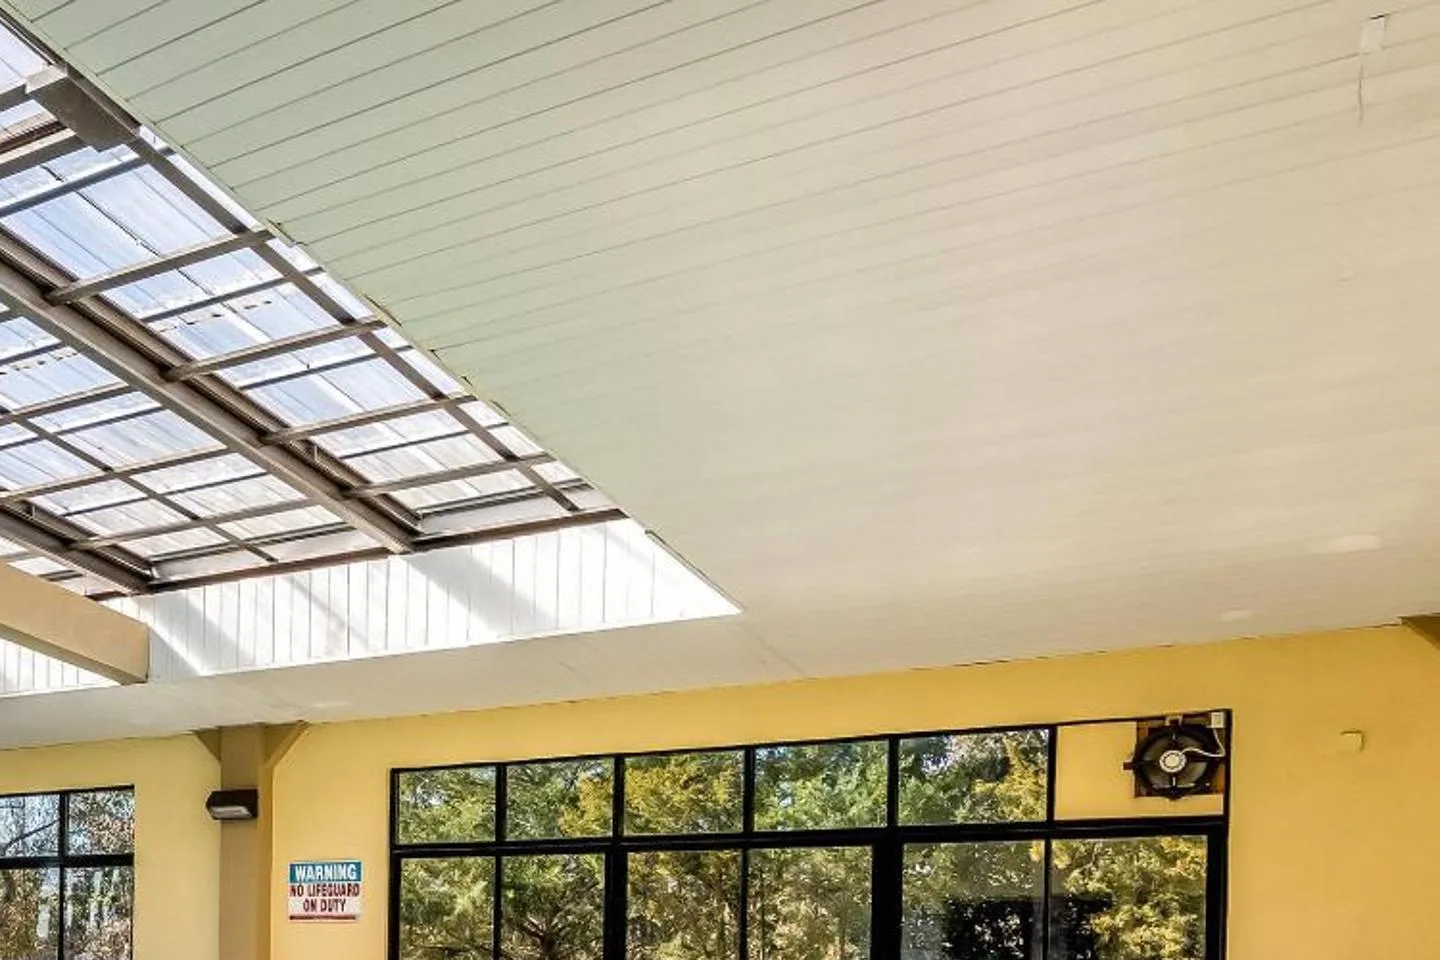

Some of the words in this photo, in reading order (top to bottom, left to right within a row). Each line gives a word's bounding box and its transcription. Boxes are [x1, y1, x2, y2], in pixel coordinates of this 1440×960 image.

[295, 863, 357, 881] WARNING
[289, 885, 304, 897] NO
[308, 883, 360, 897] LIFEGUARD
[303, 899, 317, 912] ON
[320, 898, 346, 912] DUTY
